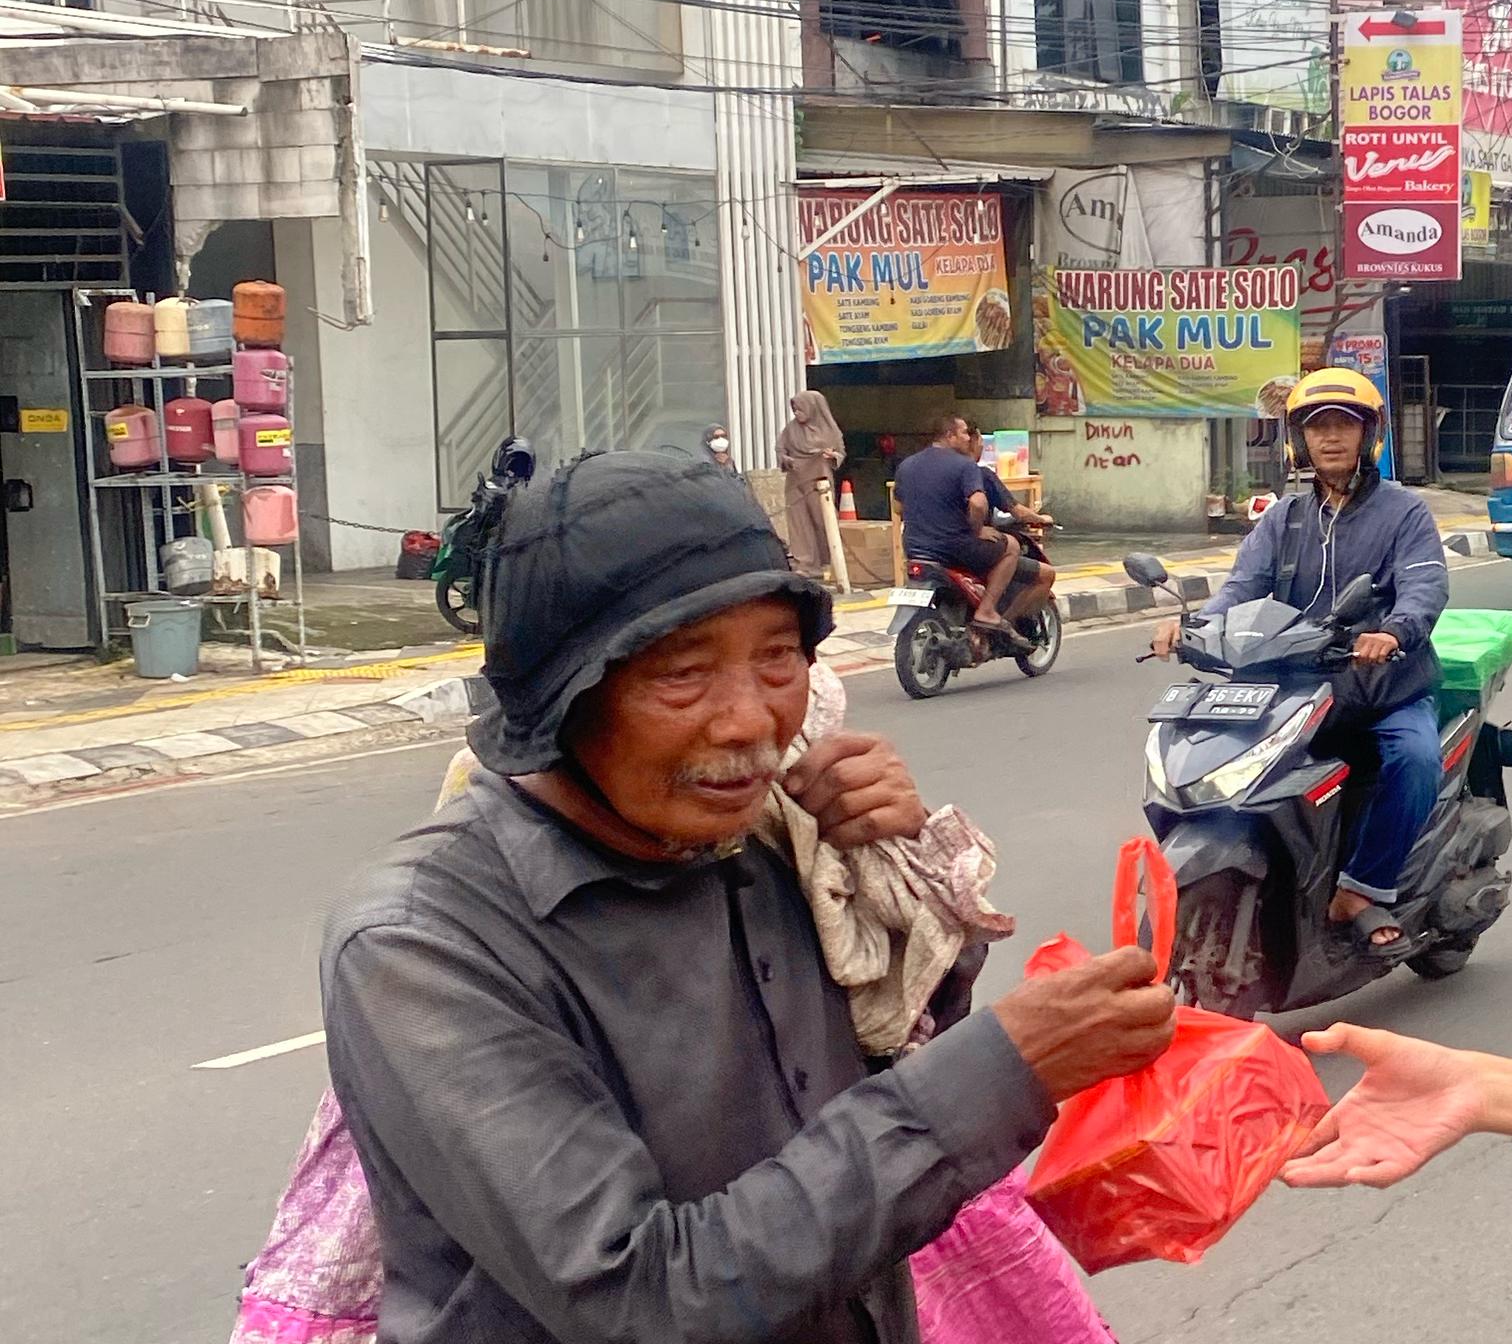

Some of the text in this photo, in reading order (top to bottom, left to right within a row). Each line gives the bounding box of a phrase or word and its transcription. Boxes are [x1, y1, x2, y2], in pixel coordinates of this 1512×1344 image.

[1350, 84, 1451, 101] LAPIS TALAS
[1369, 105, 1431, 121] BOGOR
[1345, 132, 1447, 145] ROTI UNYIL
[1344, 144, 1456, 182] Venus
[1404, 180, 1455, 194] Bakery
[896, 199, 950, 246] SATE
[951, 199, 1001, 246] SOLO
[1360, 220, 1438, 243] Amanda
[808, 251, 864, 294] PAK
[872, 252, 929, 292] MUL
[936, 257, 976, 275] KELAPA
[1411, 263, 1443, 273] KUKUS
[1056, 267, 1297, 311] WARUNG SATE SOLO
[1083, 315, 1272, 350] PAK MUL
[1111, 355, 1215, 370] KELAPA DUA
[1165, 689, 1179, 702] B
[1233, 689, 1268, 703] EKV
